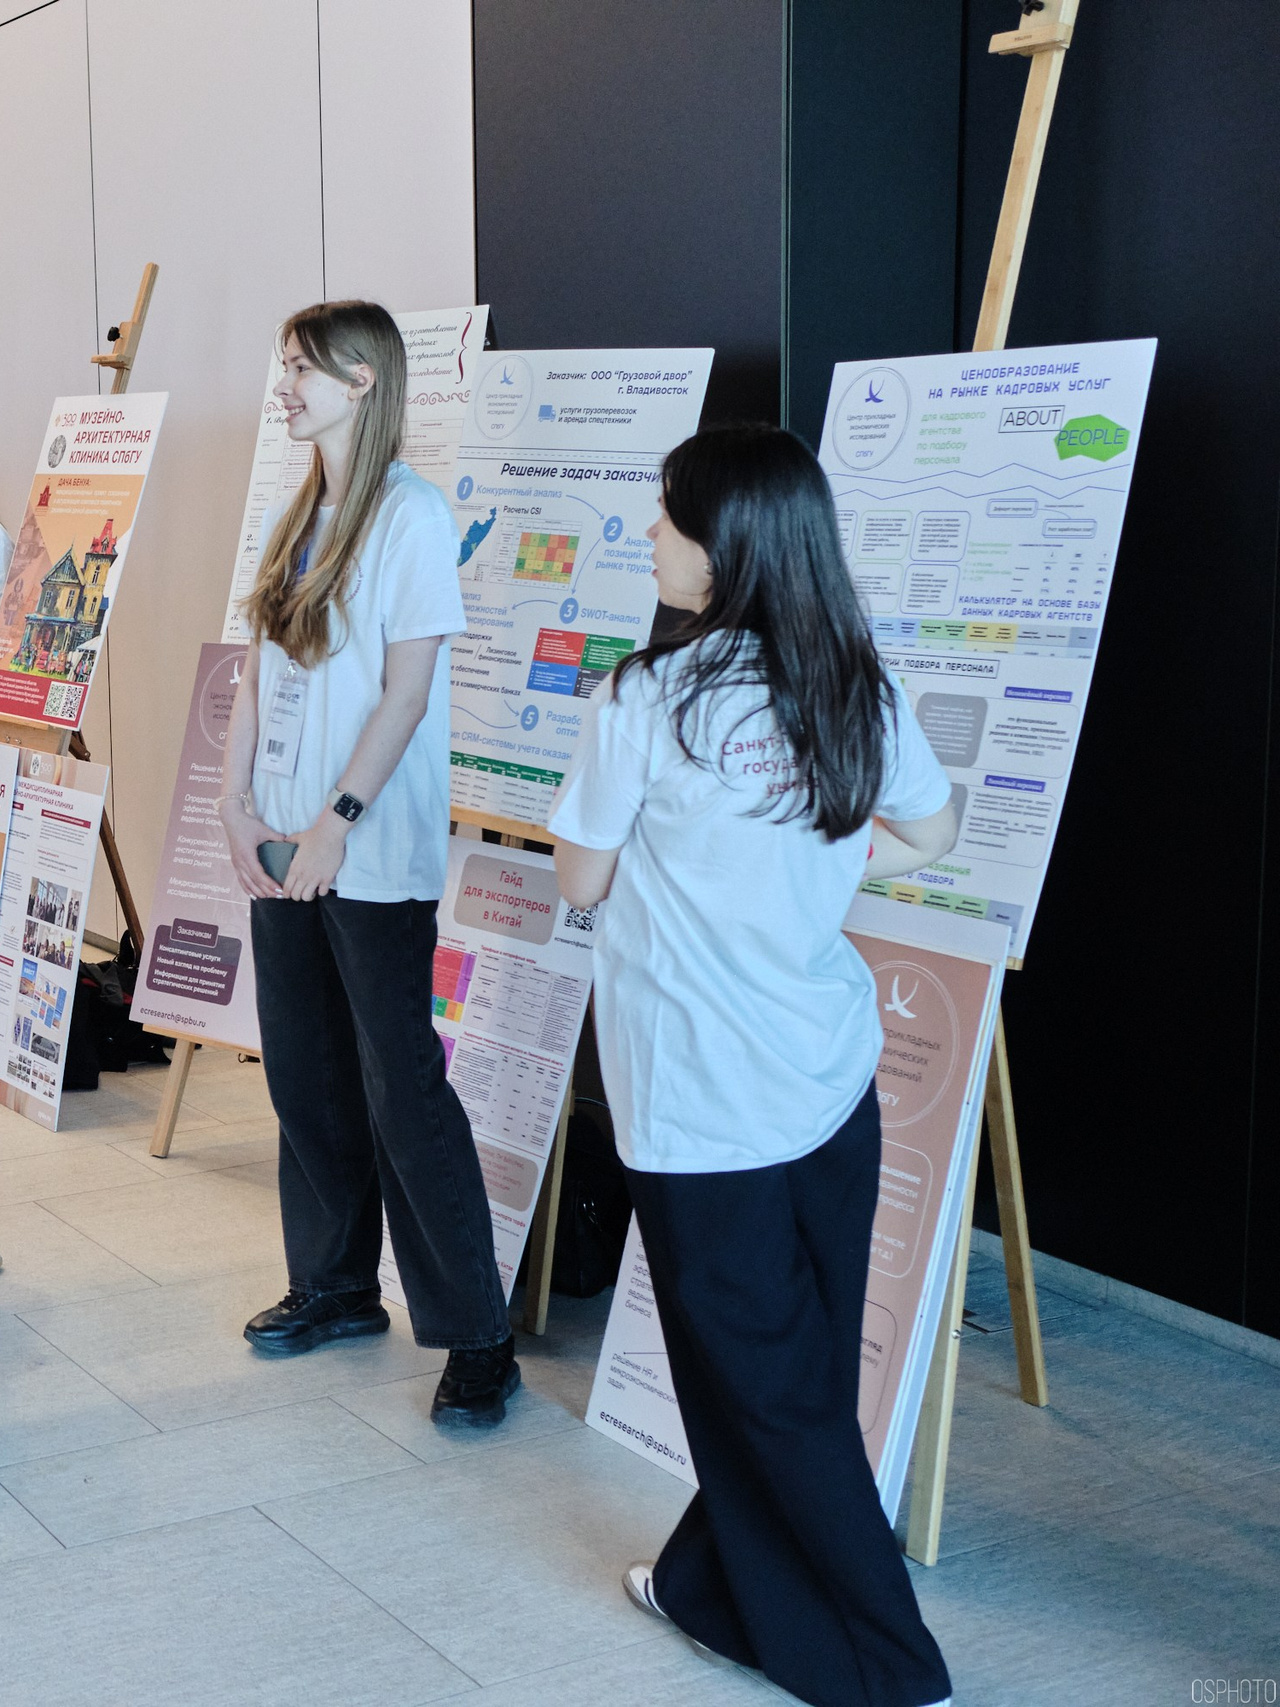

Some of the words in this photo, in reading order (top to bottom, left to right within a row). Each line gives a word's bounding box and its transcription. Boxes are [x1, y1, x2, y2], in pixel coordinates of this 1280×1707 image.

[546, 371, 587, 380] Заказчик:
[590, 370, 612, 380] ООО
[961, 362, 1080, 381] ЦЕНООБРАЗОВАНИЕ
[626, 385, 689, 396] Владивосток
[928, 388, 943, 399] НА
[950, 385, 989, 398] РЫНКЕ
[995, 381, 1060, 396] КАДРОВЫХ
[1068, 377, 1111, 391] УСЛУГ
[79, 408, 125, 425] МУЗЕЙНО-
[560, 407, 582, 415] услуги
[582, 407, 637, 415] грузоперевозок
[939, 410, 987, 421] кадрового
[1003, 409, 1062, 427] ABOUT
[588, 417, 632, 425] спецтехники
[73, 429, 151, 444] АРХИТЕКТУРНАЯ
[918, 427, 962, 436] агентства
[1056, 427, 1126, 447] PEOPLE
[929, 440, 968, 451] подбору
[68, 450, 109, 464] КЛИНИКА
[111, 450, 143, 464] СПбГУ
[913, 456, 961, 465] персонала
[501, 463, 558, 478] Решение
[559, 467, 601, 481] задач
[603, 468, 662, 484] заказчи
[476, 484, 533, 498] Конкурентный
[533, 489, 563, 499] анализ
[503, 505, 529, 515] Расчеты
[604, 549, 642, 560] позиций
[595, 561, 624, 571] рынке
[626, 563, 652, 574] труда
[461, 592, 482, 601] нализ
[958, 595, 1018, 606] КАЛЬКУЛЯТОР
[1022, 598, 1033, 606] НА
[1038, 599, 1072, 608] ОСНОВЕ
[1077, 600, 1101, 609] БАЗЫ
[580, 607, 641, 625] SWOT-анализ
[961, 607, 994, 617] ДАННЫХ
[998, 609, 1042, 619] КАДРОВЫХ
[1047, 612, 1093, 621] АГЕНТСТВ
[904, 659, 941, 671] ПОДБОРА
[945, 662, 995, 674] ПЕРСОНАЛА
[524, 711, 535, 725] 5
[461, 731, 516, 750] CRM-системы
[516, 742, 540, 755] учета
[541, 747, 573, 761] оказан
[188, 774, 223, 784] микроэконо
[499, 870, 523, 888] Гайд
[918, 872, 955, 886] ПОДБОРА
[463, 884, 483, 898] для
[484, 891, 551, 915] экспортеров
[483, 911, 489, 920] в
[491, 911, 523, 929] Китай
[177, 926, 212, 940] Заказчикам
[159, 944, 202, 959] Консалтинговые
[202, 953, 222, 963] услуги
[156, 956, 175, 965] Новый
[175, 961, 193, 970] взгляд
[200, 966, 228, 978] проблему
[154, 969, 188, 982] Информация
[199, 978, 226, 989] принятия
[152, 977, 193, 992] стратегических
[193, 986, 219, 997] решений
[140, 1006, 206, 1028] ecresearch@spbu.ru
[883, 1046, 929, 1067] мических
[879, 1164, 922, 1185] вышение
[624, 1300, 652, 1319] бизнеса
[612, 1353, 642, 1373] решение
[600, 1409, 687, 1466] ecresearch@spbu.ru
